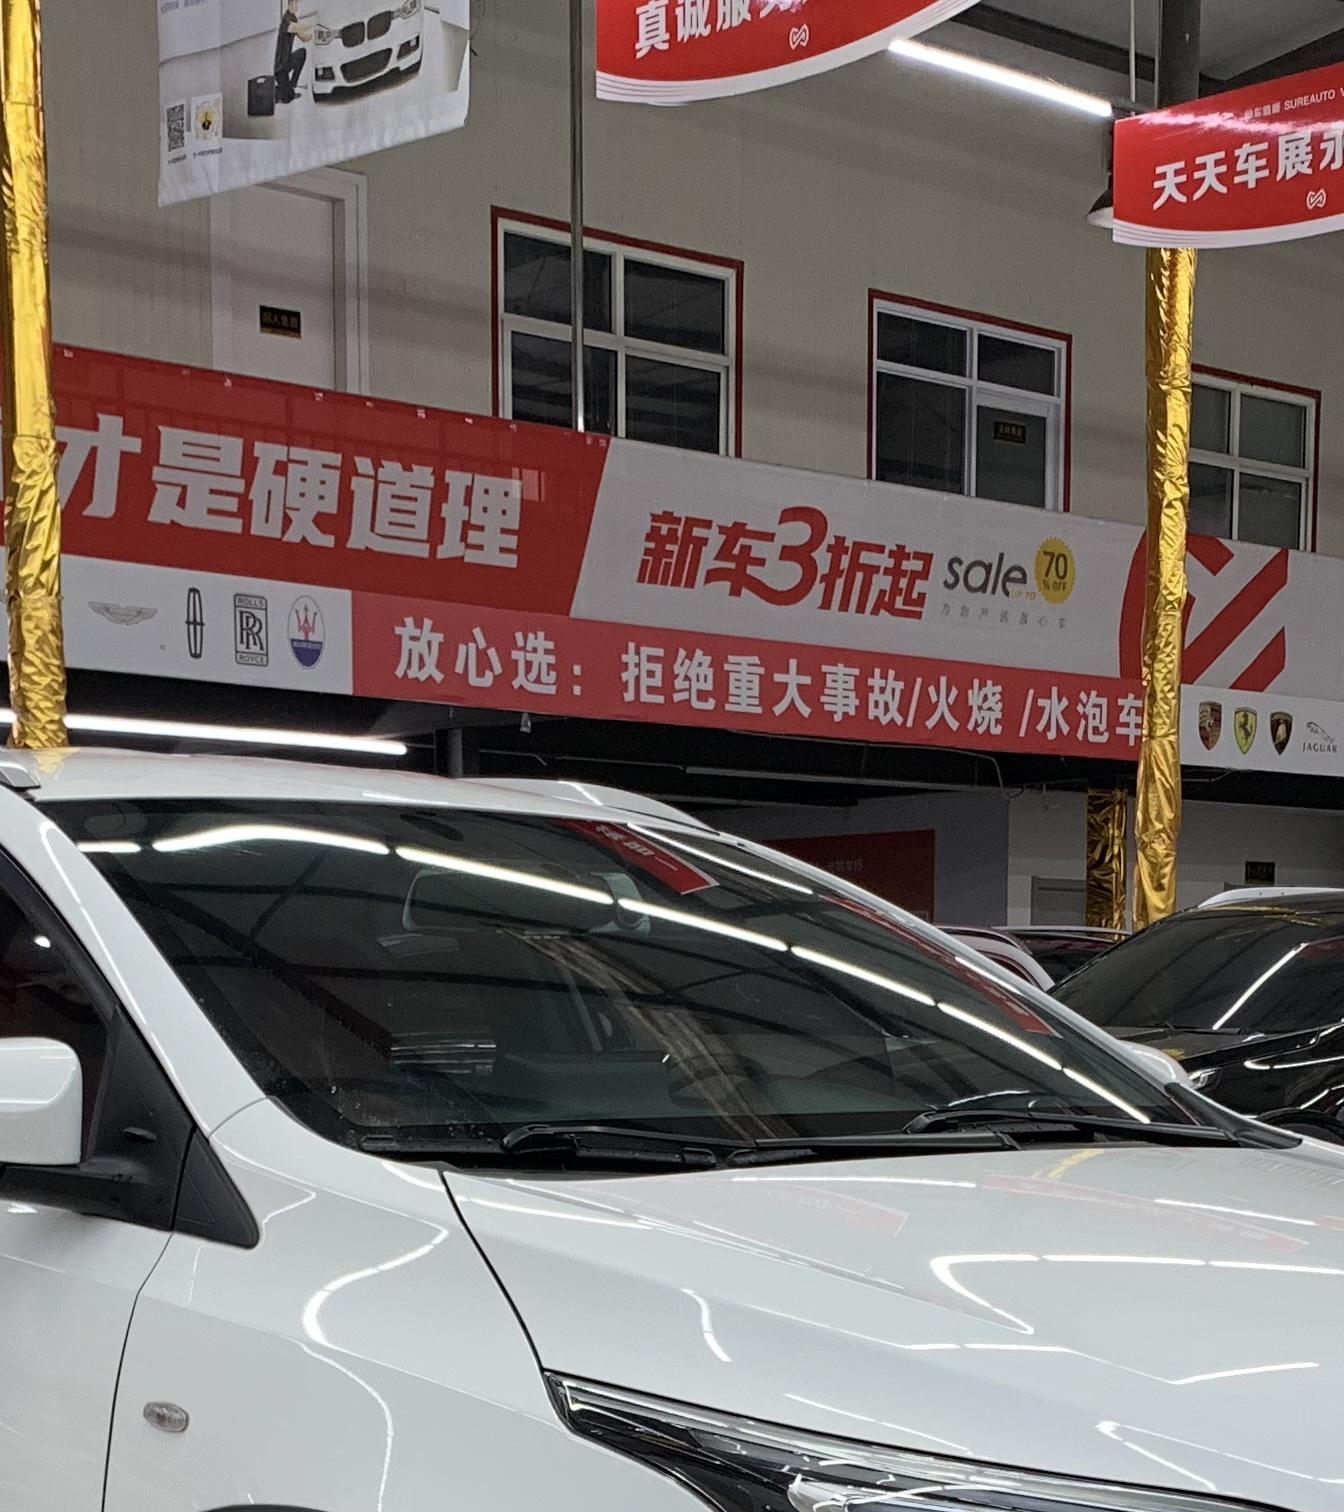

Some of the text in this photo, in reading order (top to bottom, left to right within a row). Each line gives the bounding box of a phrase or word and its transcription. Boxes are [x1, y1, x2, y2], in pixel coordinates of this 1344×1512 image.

[1284, 89, 1336, 111] SUREAUTO
[636, 505, 934, 620] 新车3折起
[943, 552, 1028, 598] sale
[1043, 550, 1068, 580] 70
[1302, 741, 1338, 754] JAGUAR
